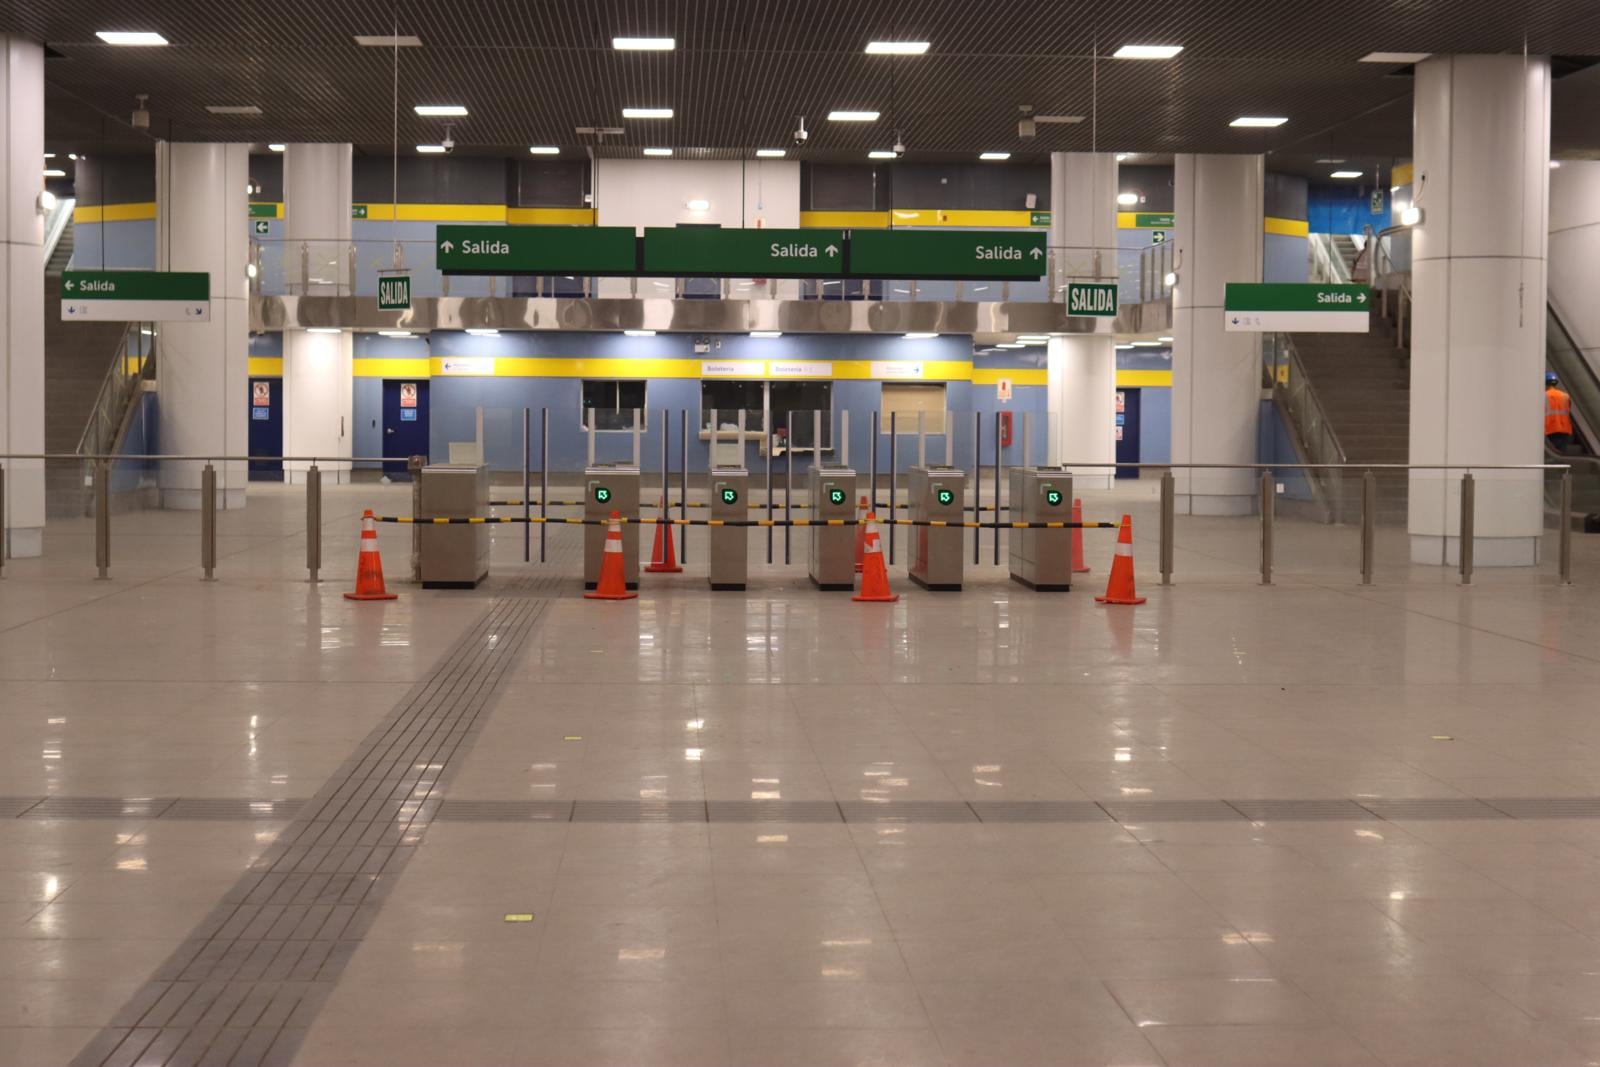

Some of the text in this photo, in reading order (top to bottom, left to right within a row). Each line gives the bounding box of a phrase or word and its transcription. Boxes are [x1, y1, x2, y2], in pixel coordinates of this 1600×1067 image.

[462, 240, 509, 254] Salida
[771, 243, 817, 257] Salida
[976, 246, 1022, 259] Salida
[80, 280, 115, 291] Salida
[381, 281, 408, 304] SALIDA
[1072, 288, 1113, 311] SALIDA
[1318, 292, 1351, 303] Salida
